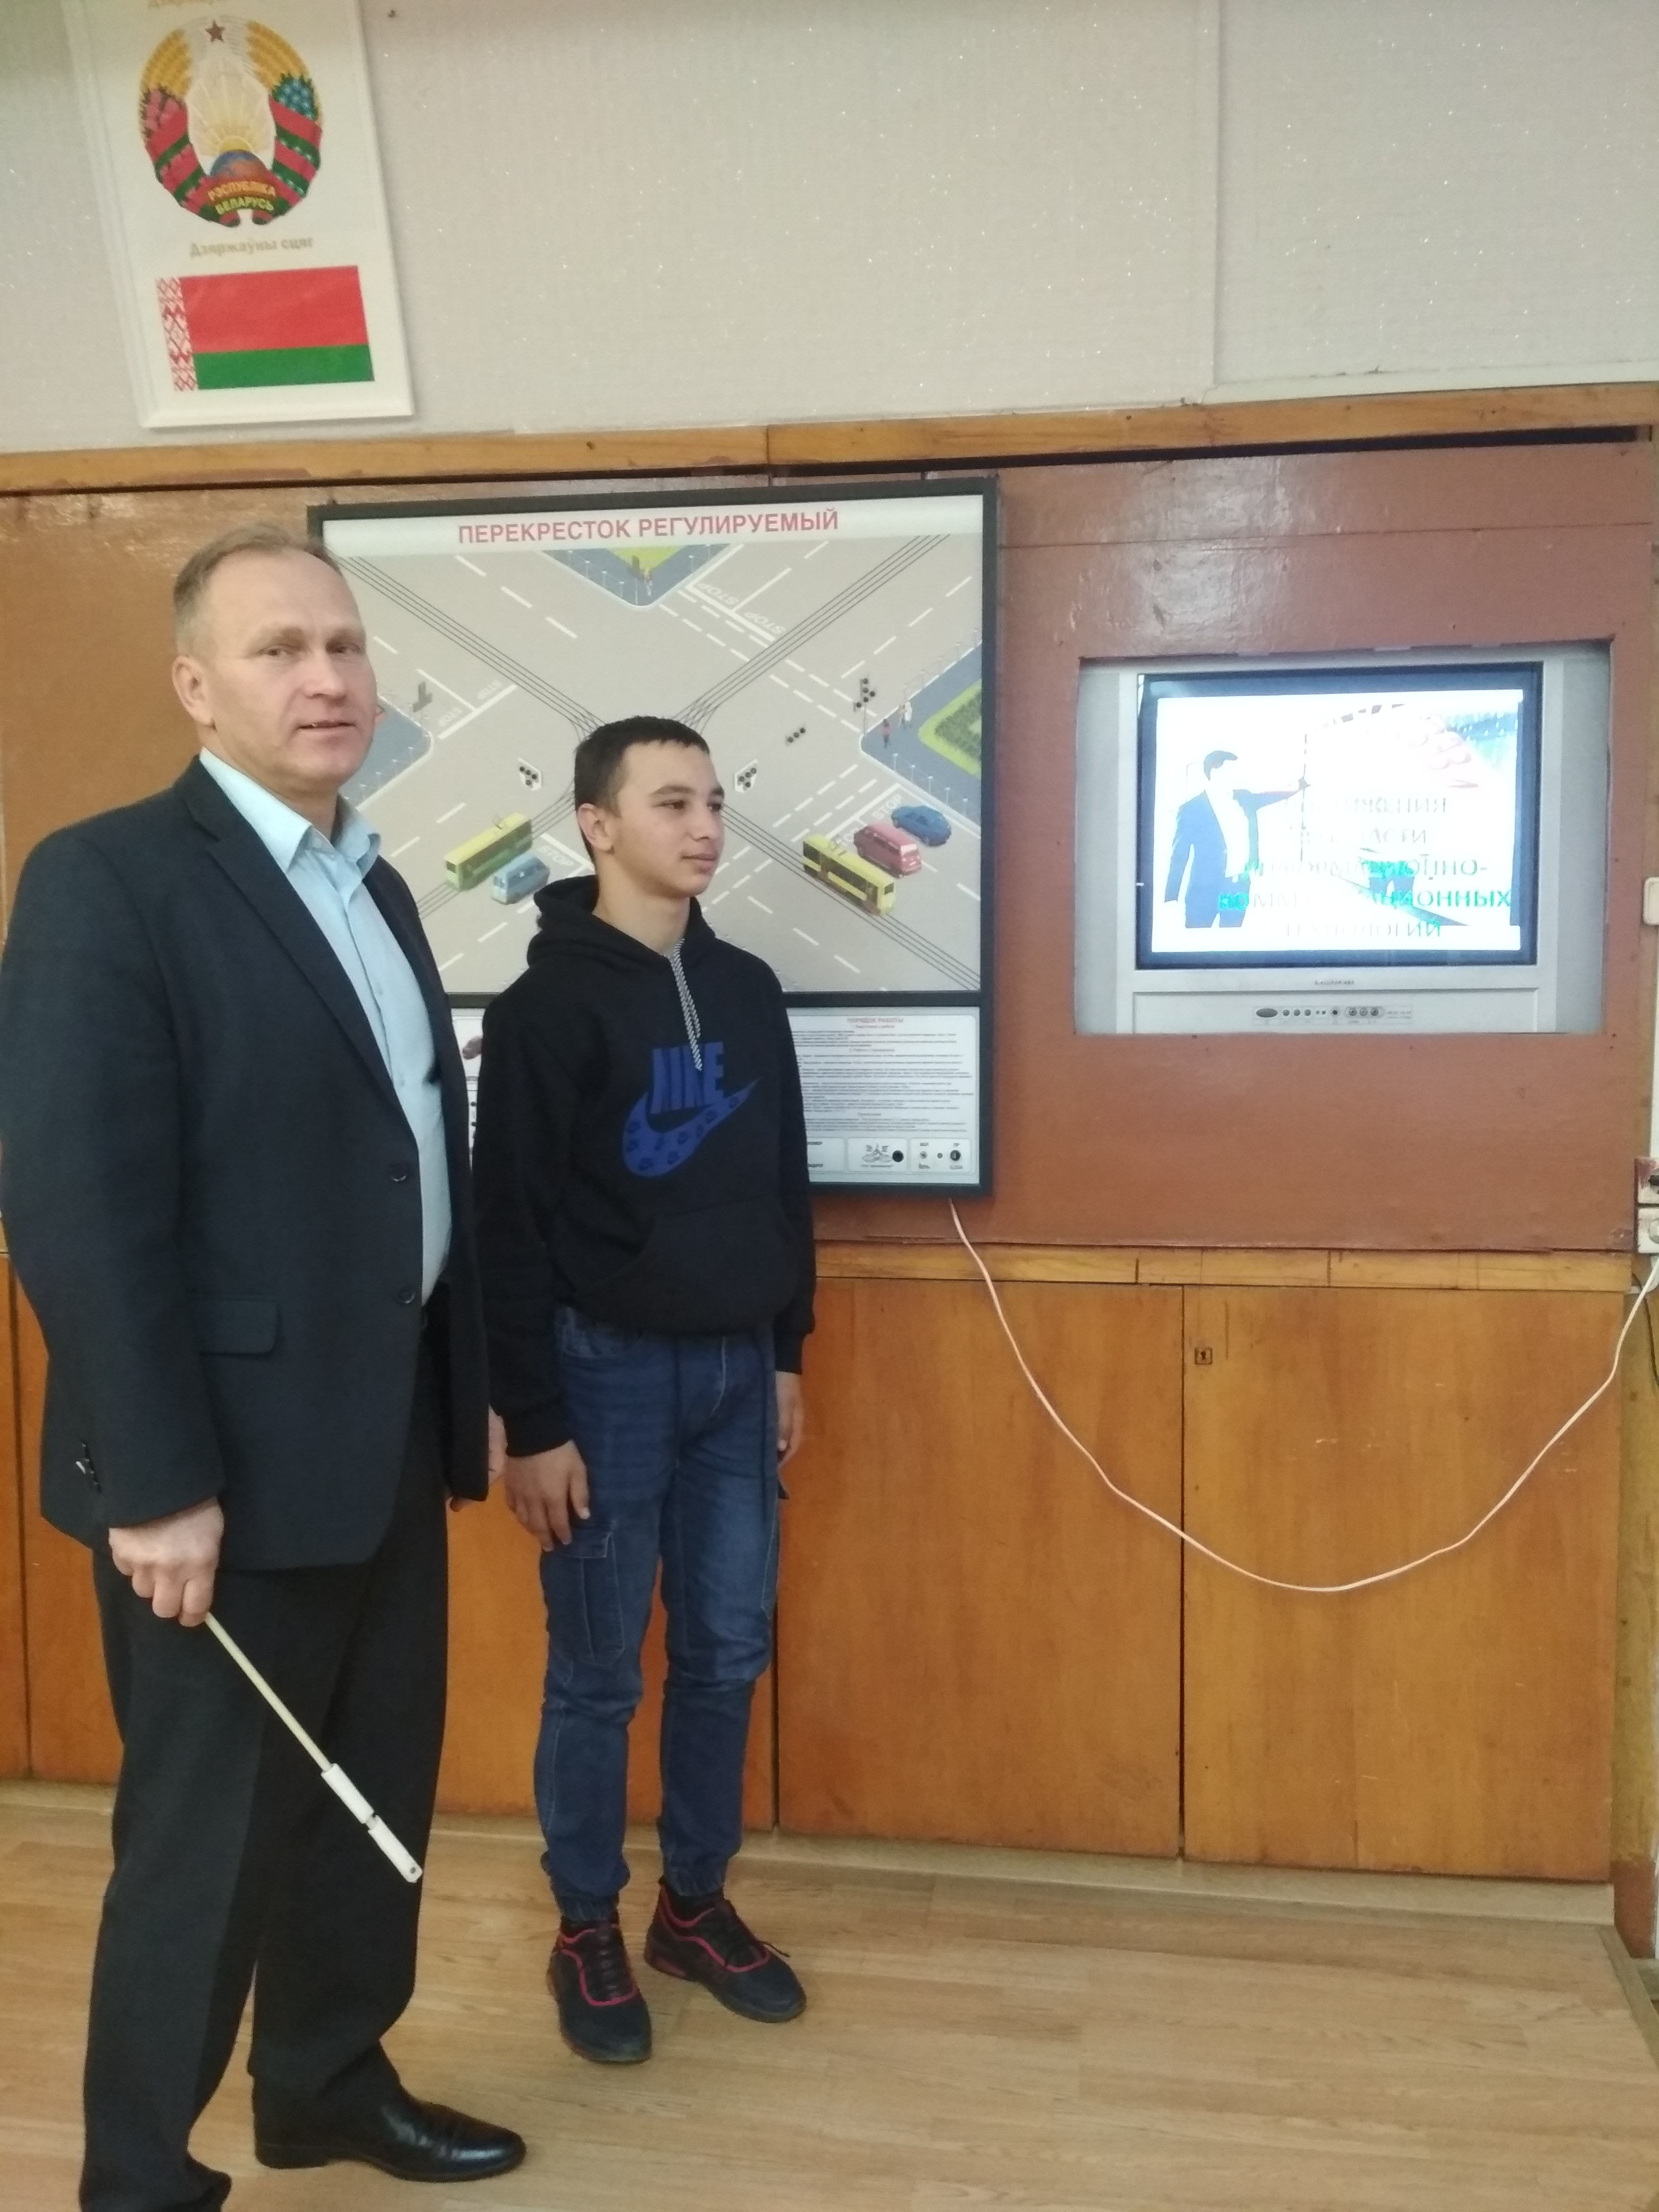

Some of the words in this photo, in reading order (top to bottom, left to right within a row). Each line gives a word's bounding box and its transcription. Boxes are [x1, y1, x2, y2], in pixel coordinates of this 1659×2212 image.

[459, 519, 631, 543] ПЕРЕКРЕСТОК
[639, 507, 839, 537] РЕГУЛИРУЕМЫЙ
[698, 583, 740, 605] STOP
[744, 612, 786, 634] STOP
[537, 845, 574, 867] STOP
